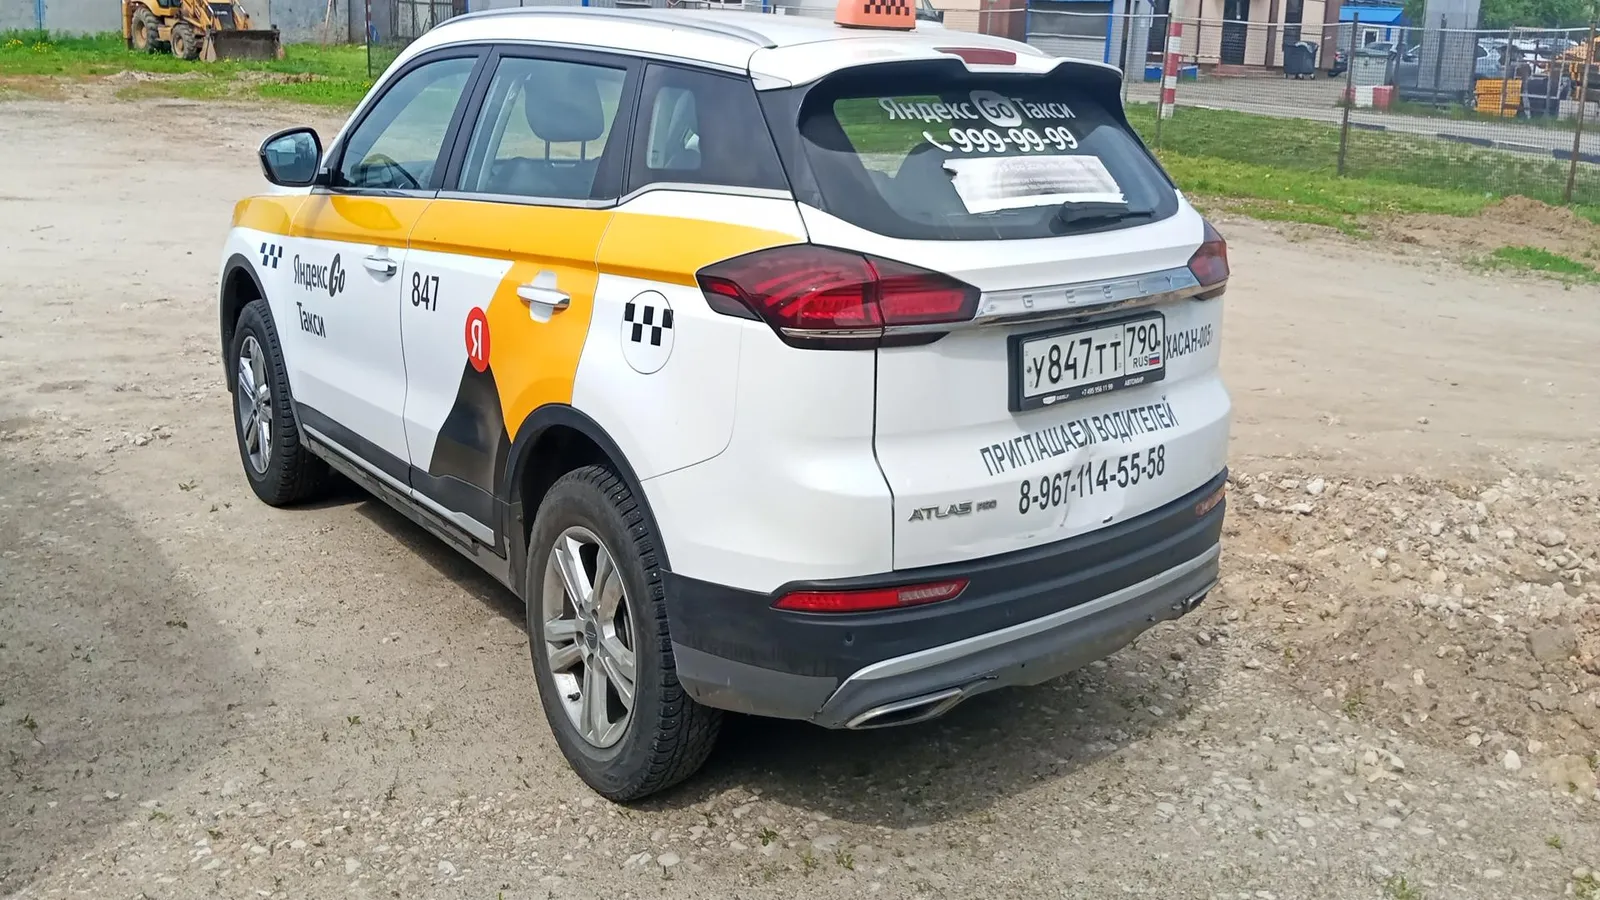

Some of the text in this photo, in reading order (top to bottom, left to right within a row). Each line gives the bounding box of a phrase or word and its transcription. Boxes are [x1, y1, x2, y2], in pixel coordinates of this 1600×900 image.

[878, 95, 1076, 123] Яндекс Go Такси
[949, 127, 1079, 153] 999-99-99
[293, 252, 346, 298] Яндекс Go
[411, 271, 440, 312] 847
[1021, 275, 1173, 309] GEELY
[296, 301, 327, 338] Такси
[471, 319, 483, 361] Я
[1126, 323, 1158, 357] 790
[1133, 356, 1149, 369] RUS
[980, 395, 1180, 477] ПРИГЛАШАЕМ ВОДИТЕЛЕЙ
[1018, 444, 1166, 515] 8-967-114-55-58
[907, 499, 997, 522] ATLAS PRO
